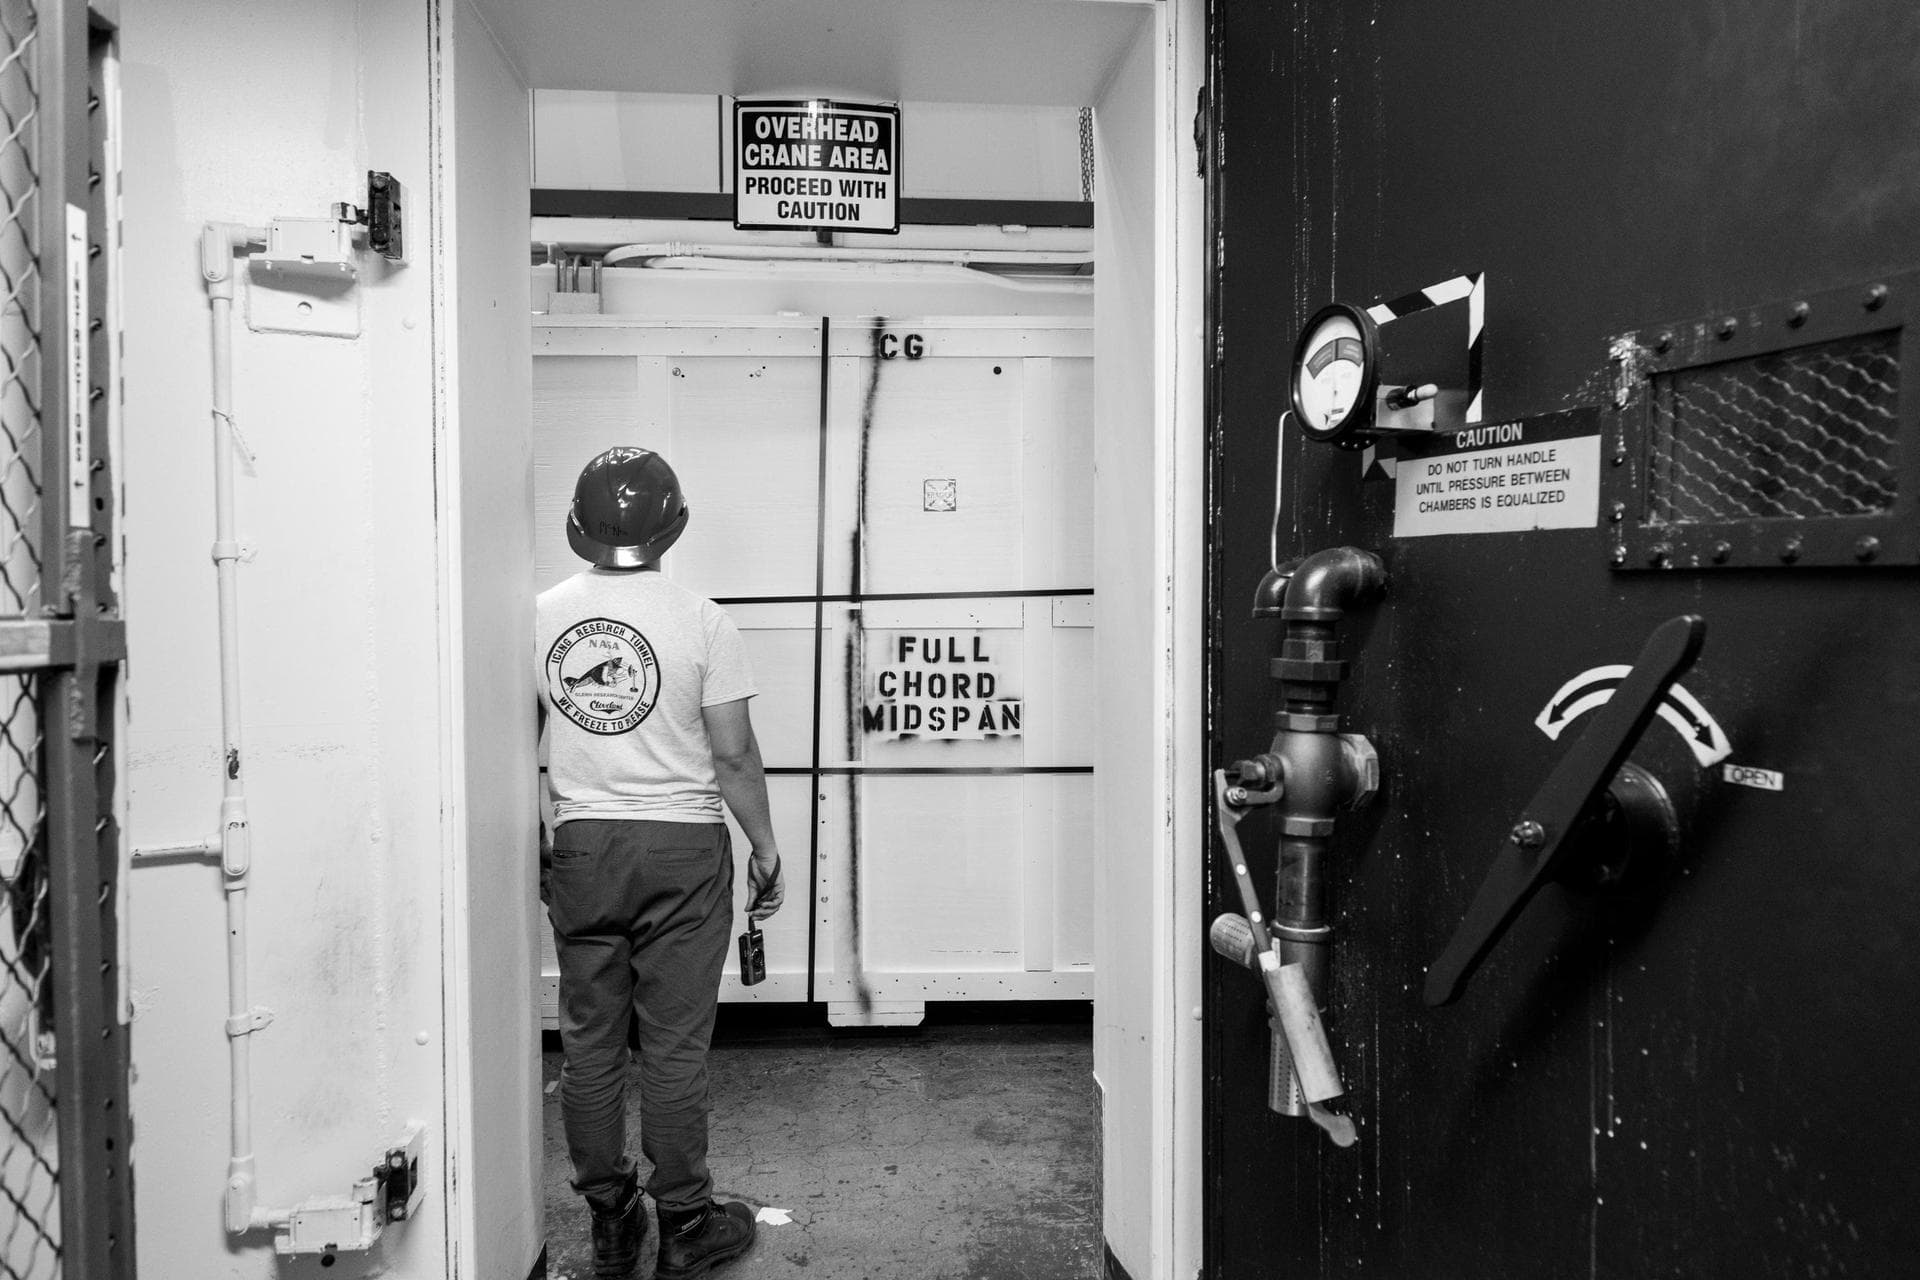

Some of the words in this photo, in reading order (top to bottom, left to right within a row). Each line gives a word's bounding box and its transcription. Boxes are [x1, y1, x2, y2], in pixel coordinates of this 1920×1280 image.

[755, 116, 879, 143] OVERHEAD
[745, 143, 822, 167] CRANE
[829, 146, 889, 171] AREA
[745, 177, 832, 196] PROCEED
[839, 179, 886, 199] WITH
[777, 201, 860, 221] CAUTION
[1456, 422, 1523, 448] CAUTION
[1428, 463, 1443, 476] DO
[1446, 460, 1468, 474] NOT
[1473, 455, 1502, 472] TURN
[1507, 449, 1556, 467] HANDLE
[1416, 482, 1444, 495] UNTIL
[1448, 475, 1505, 492] PRESSURE
[1511, 468, 1570, 486] BETWEEN
[1419, 498, 1476, 513] CHAMBERS
[1481, 496, 1492, 509] IS
[1497, 490, 1565, 507] EQUALIZED
[551, 638, 572, 664] ICING
[630, 634, 654, 669] TUNNEL
[588, 639, 620, 650] NASA
[899, 636, 990, 663] FULL
[879, 671, 995, 699] CHORD
[558, 696, 573, 712] WE
[573, 711, 608, 731] FREEZE
[611, 722, 624, 730] TO
[863, 704, 1020, 733] MIDSPAN
[1732, 767, 1775, 786] OPEN
